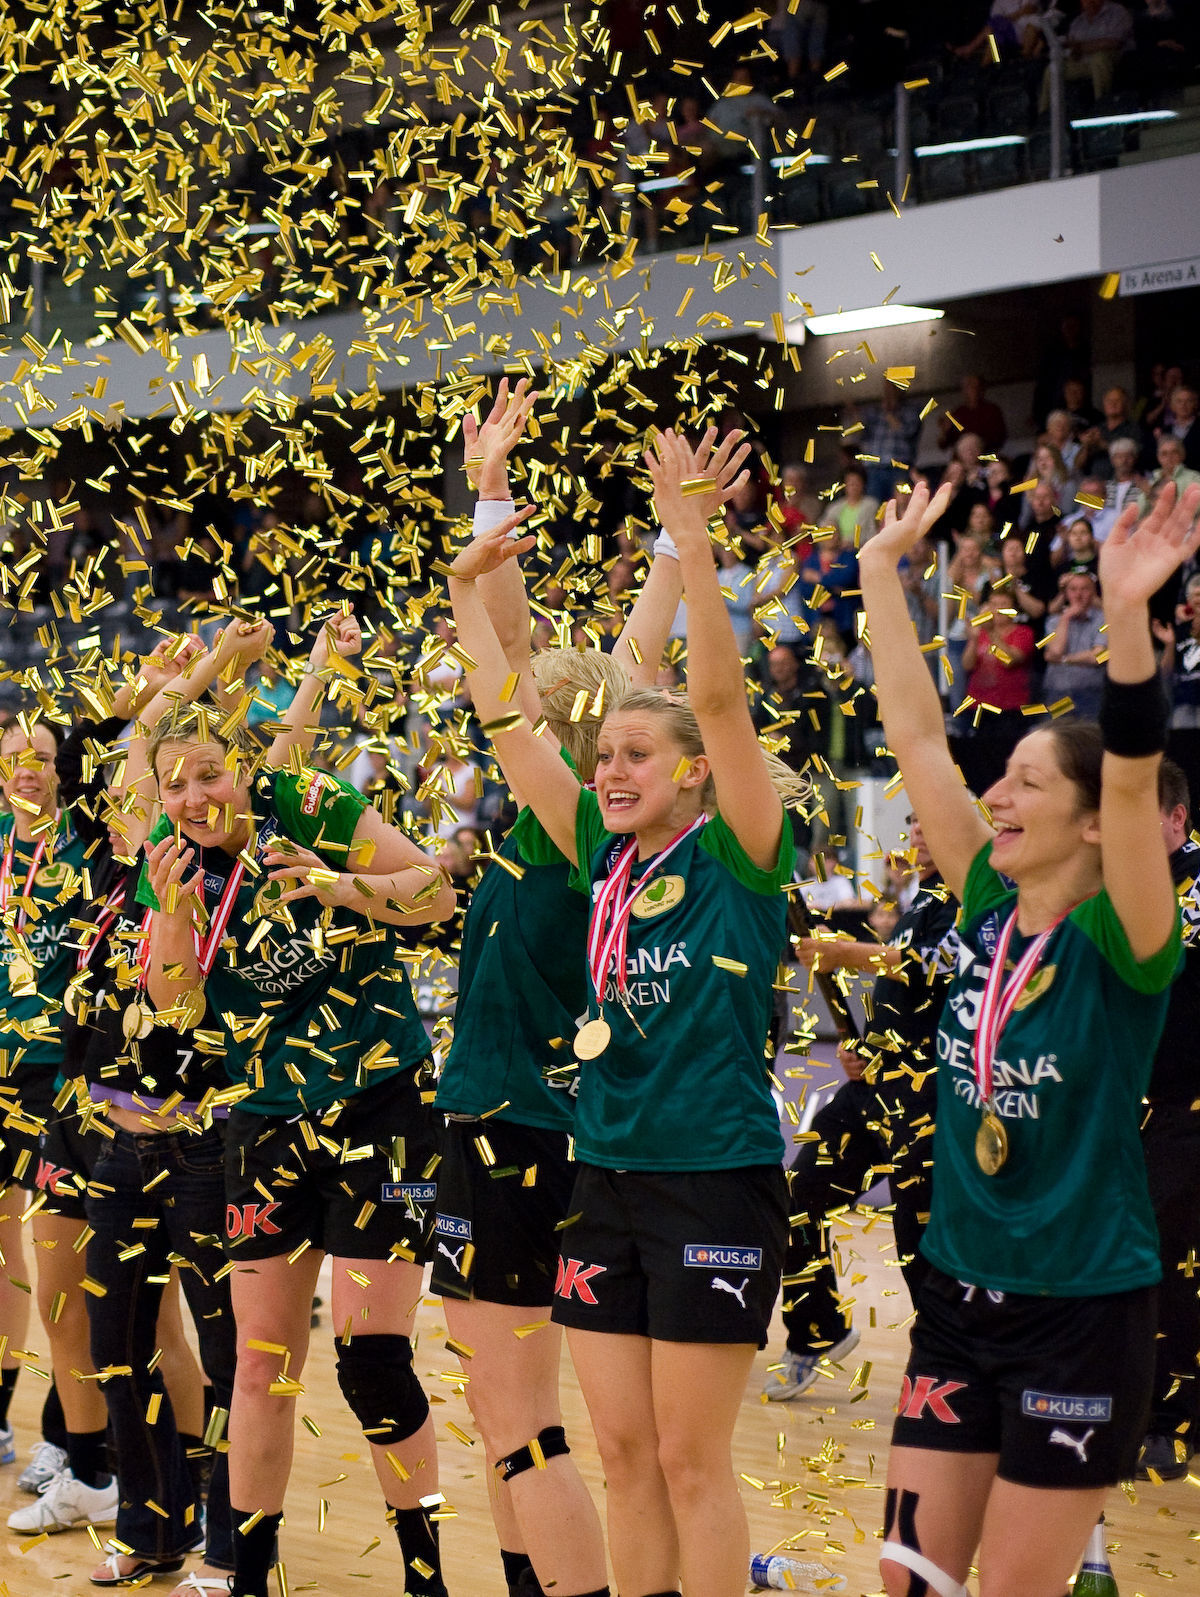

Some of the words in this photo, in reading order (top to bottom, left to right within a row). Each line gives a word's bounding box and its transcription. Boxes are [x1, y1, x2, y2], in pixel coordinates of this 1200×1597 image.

[603, 979, 671, 1006] ØKKEN
[226, 1201, 283, 1239] OK
[688, 1249, 758, 1267] LOKUS.dk
[1027, 1396, 1107, 1417] LOKUS.dk
